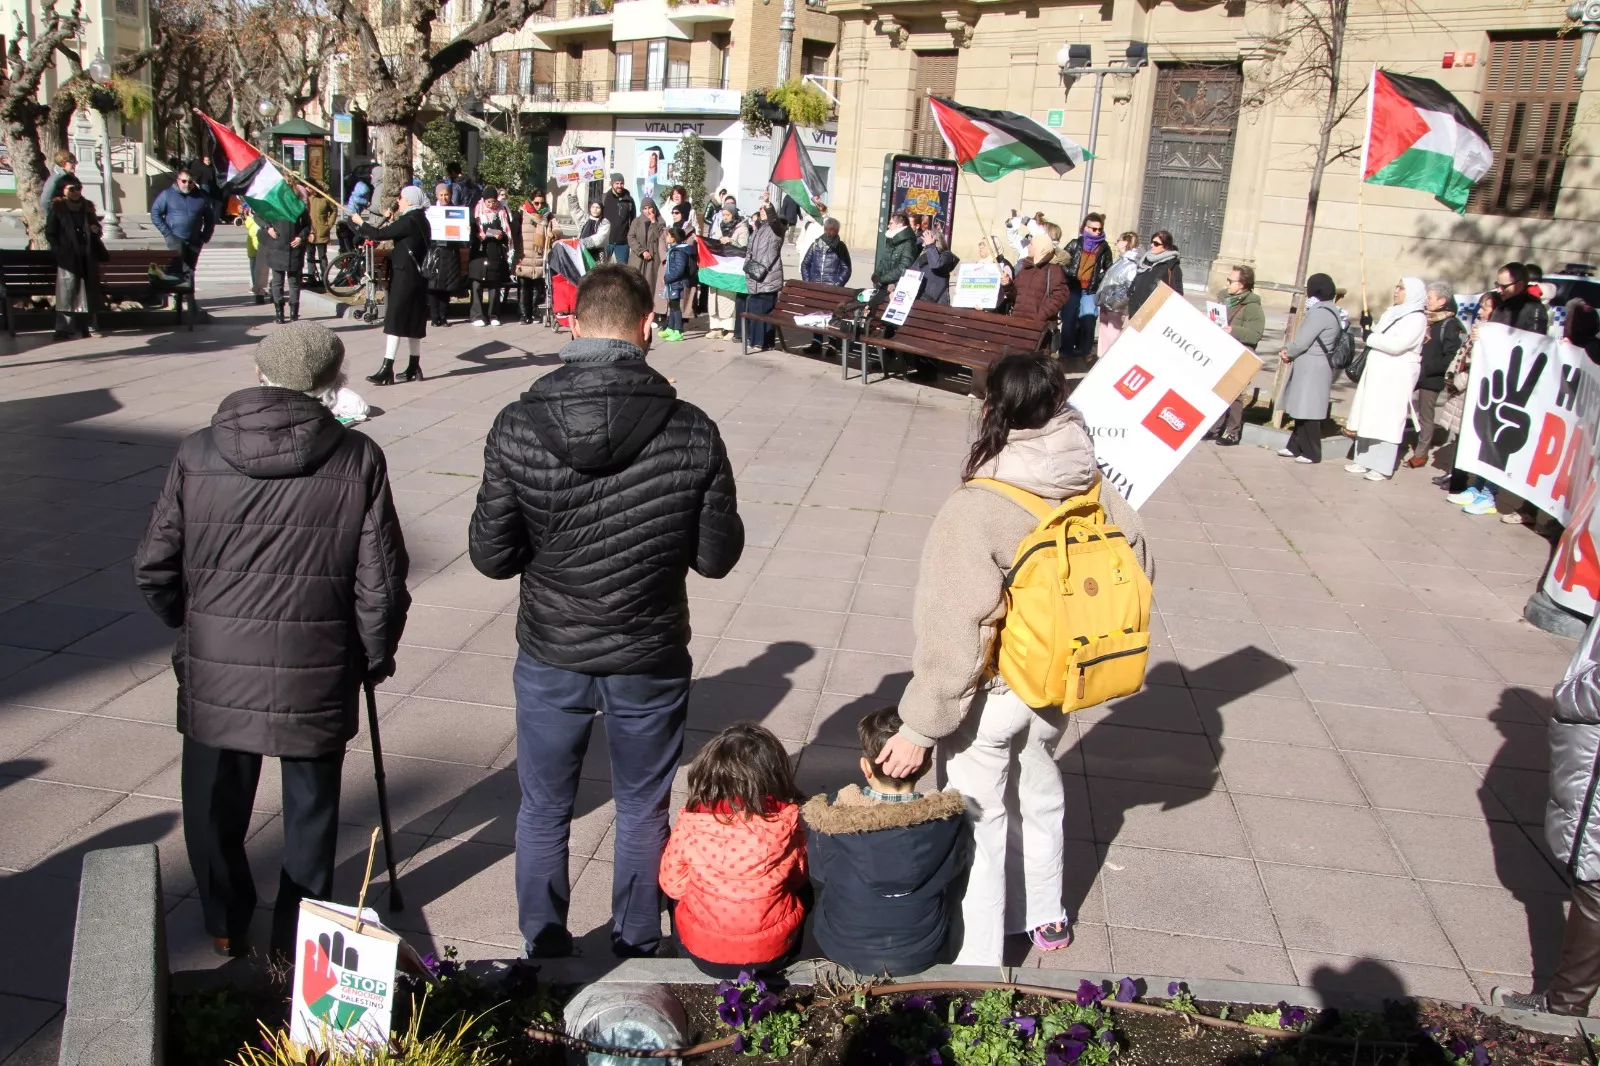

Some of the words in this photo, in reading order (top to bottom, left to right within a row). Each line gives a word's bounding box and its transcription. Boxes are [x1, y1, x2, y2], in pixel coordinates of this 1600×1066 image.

[645, 122, 704, 134] VITALDENT
[812, 130, 837, 146] VIT
[941, 173, 951, 192] V
[1162, 325, 1214, 368] BOICOT
[1122, 368, 1146, 392] LU
[341, 973, 386, 994] STOP
[341, 986, 385, 1003] GENOCIDIO
[341, 993, 384, 1010] PALESTINO
